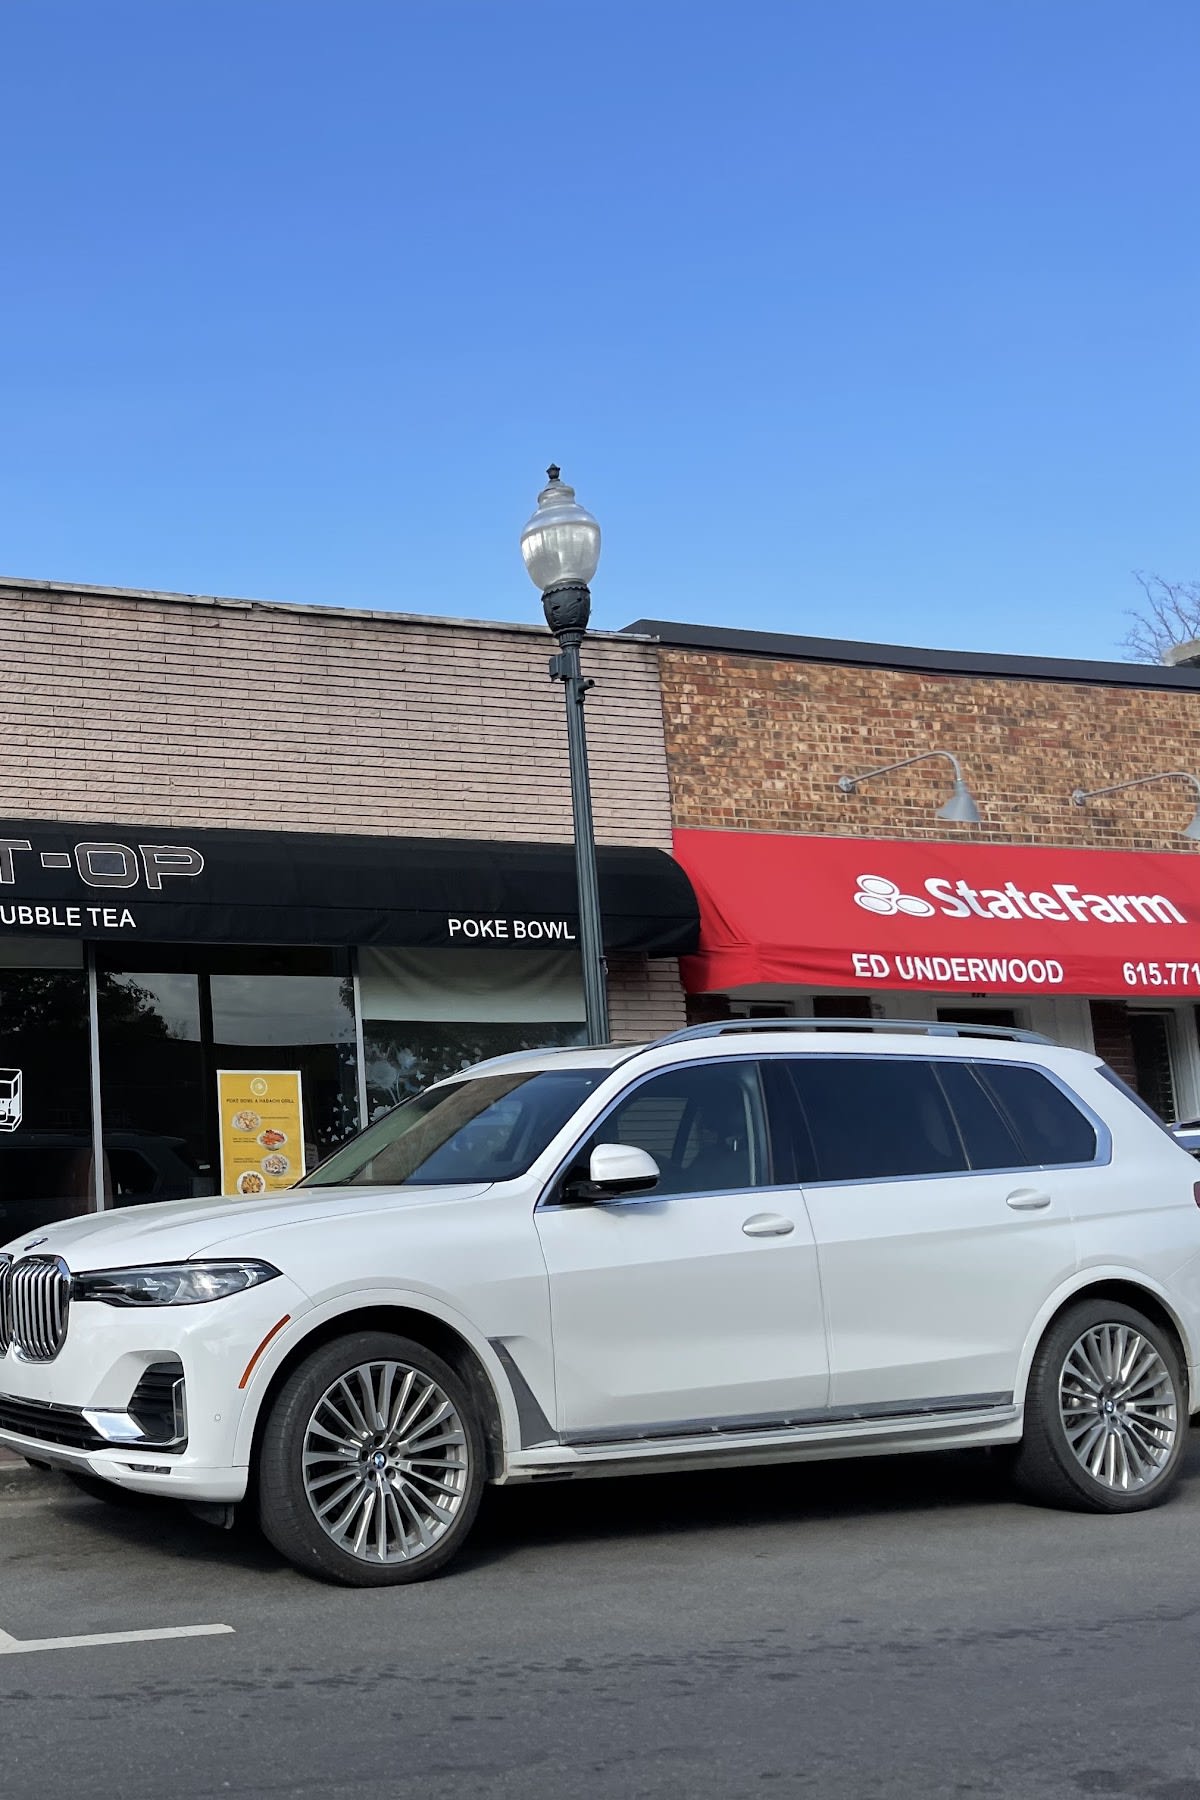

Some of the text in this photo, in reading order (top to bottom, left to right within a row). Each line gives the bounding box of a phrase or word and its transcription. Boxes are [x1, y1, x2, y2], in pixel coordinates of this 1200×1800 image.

[86, 907, 137, 928] TEA
[447, 918, 576, 940] POKE BOWL
[851, 952, 1064, 984] ED UNDERWOOD
